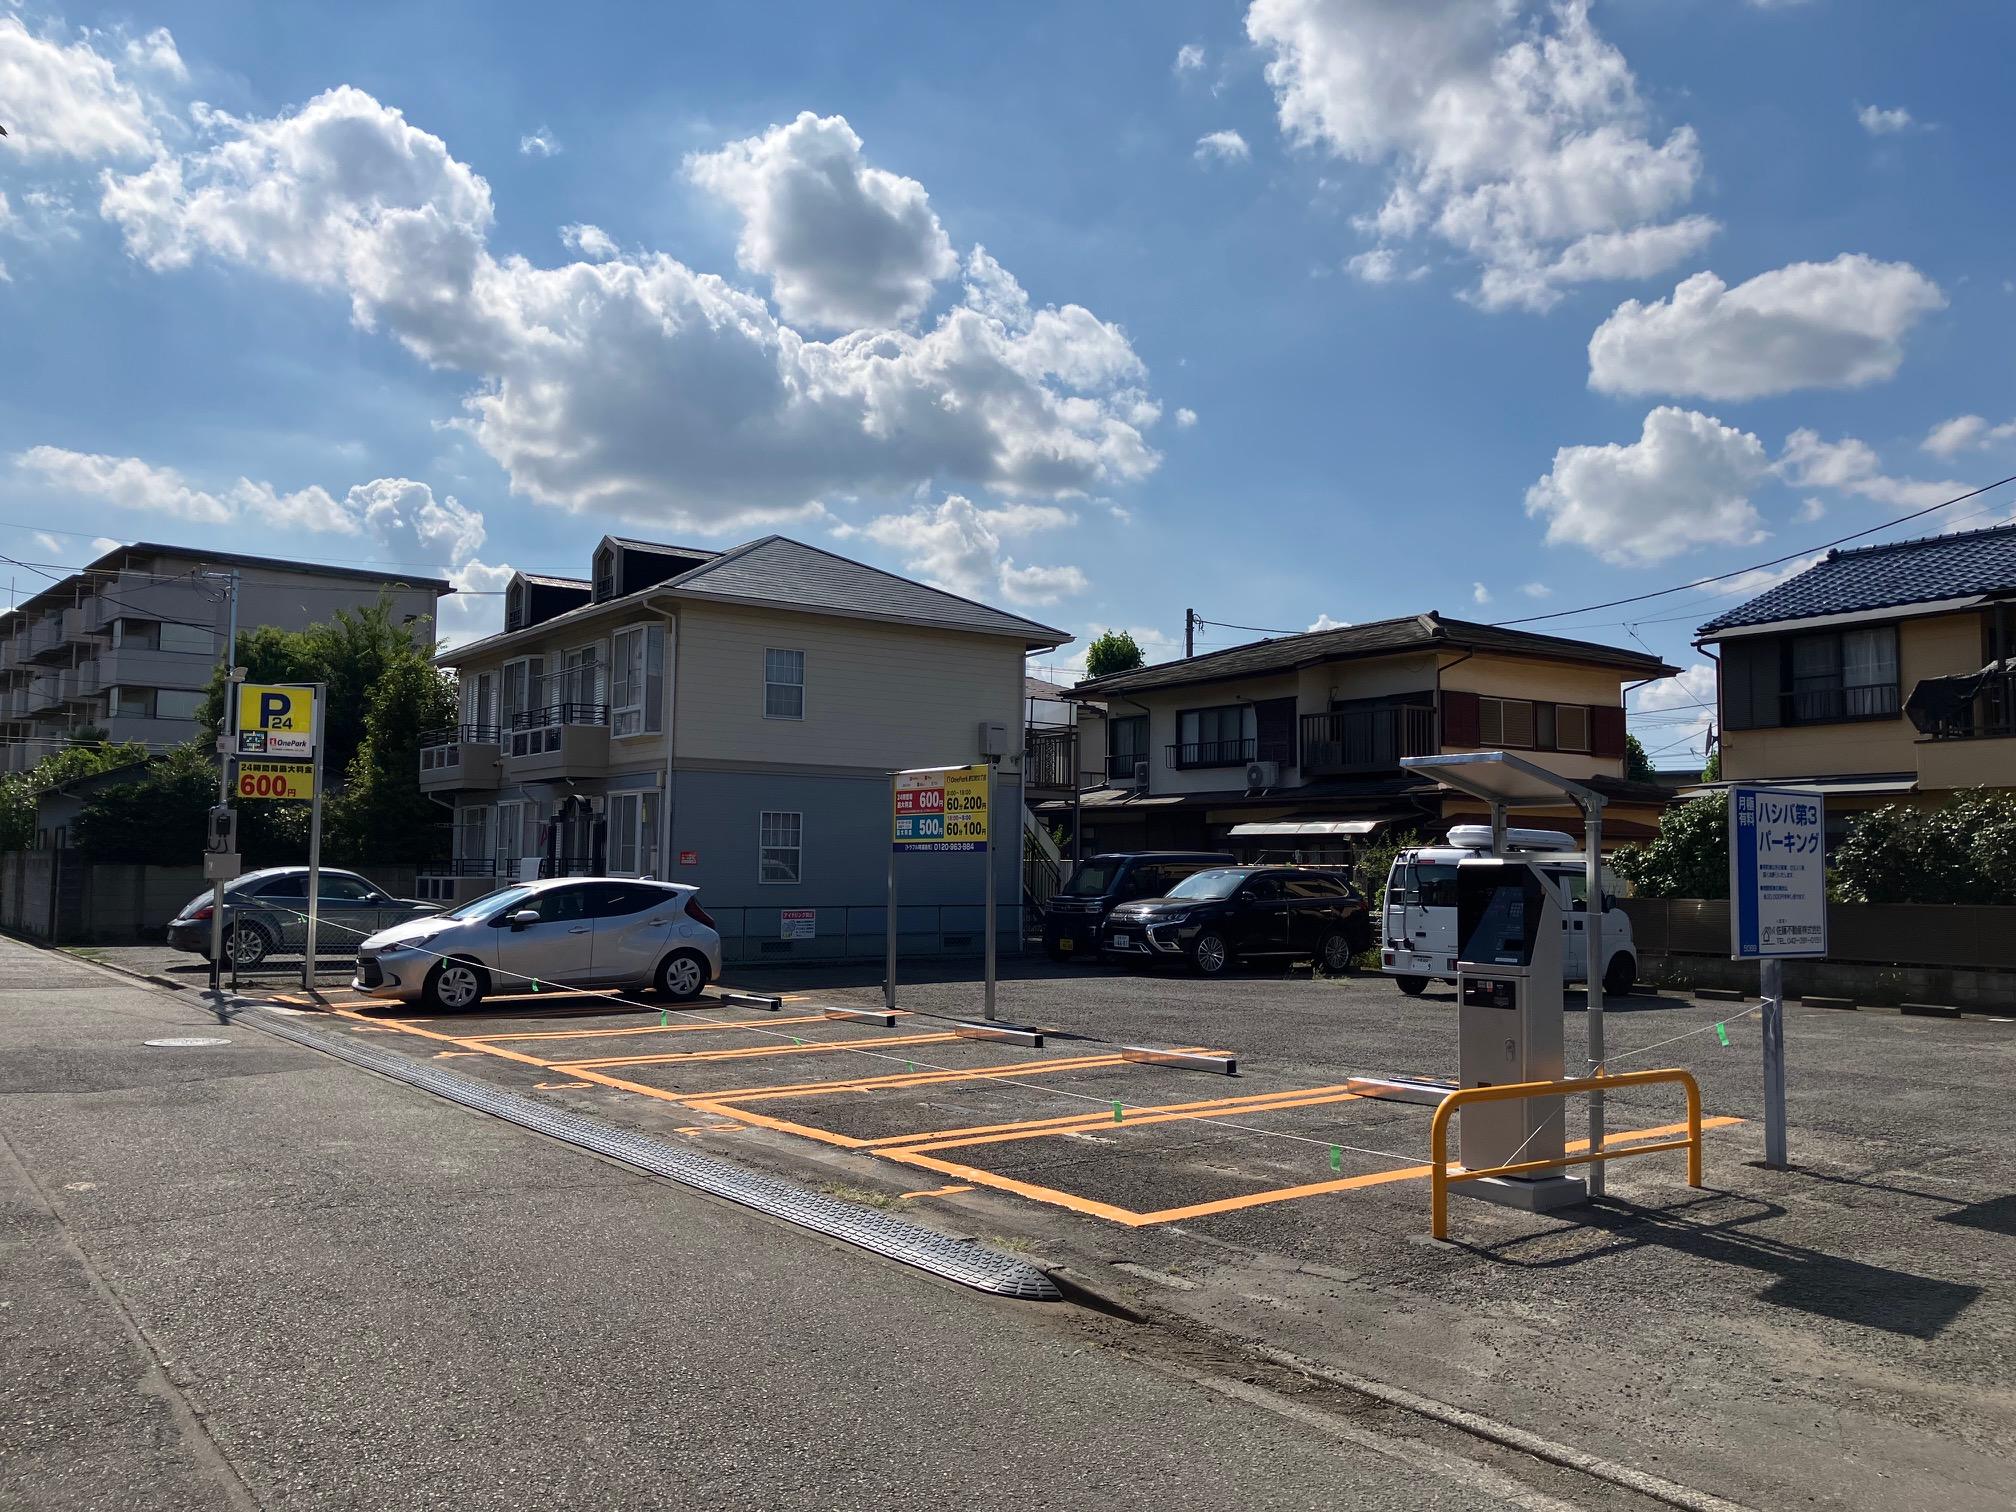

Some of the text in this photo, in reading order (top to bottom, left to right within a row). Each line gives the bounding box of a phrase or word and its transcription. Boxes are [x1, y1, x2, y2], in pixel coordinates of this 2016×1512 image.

[259, 692, 291, 729] P
[271, 717, 293, 730] 24
[277, 738, 307, 748] OnePark
[240, 773, 297, 797] 600円
[919, 791, 943, 808] 600円
[919, 818, 943, 836] 500円
[1759, 829, 1820, 854] パーキング
